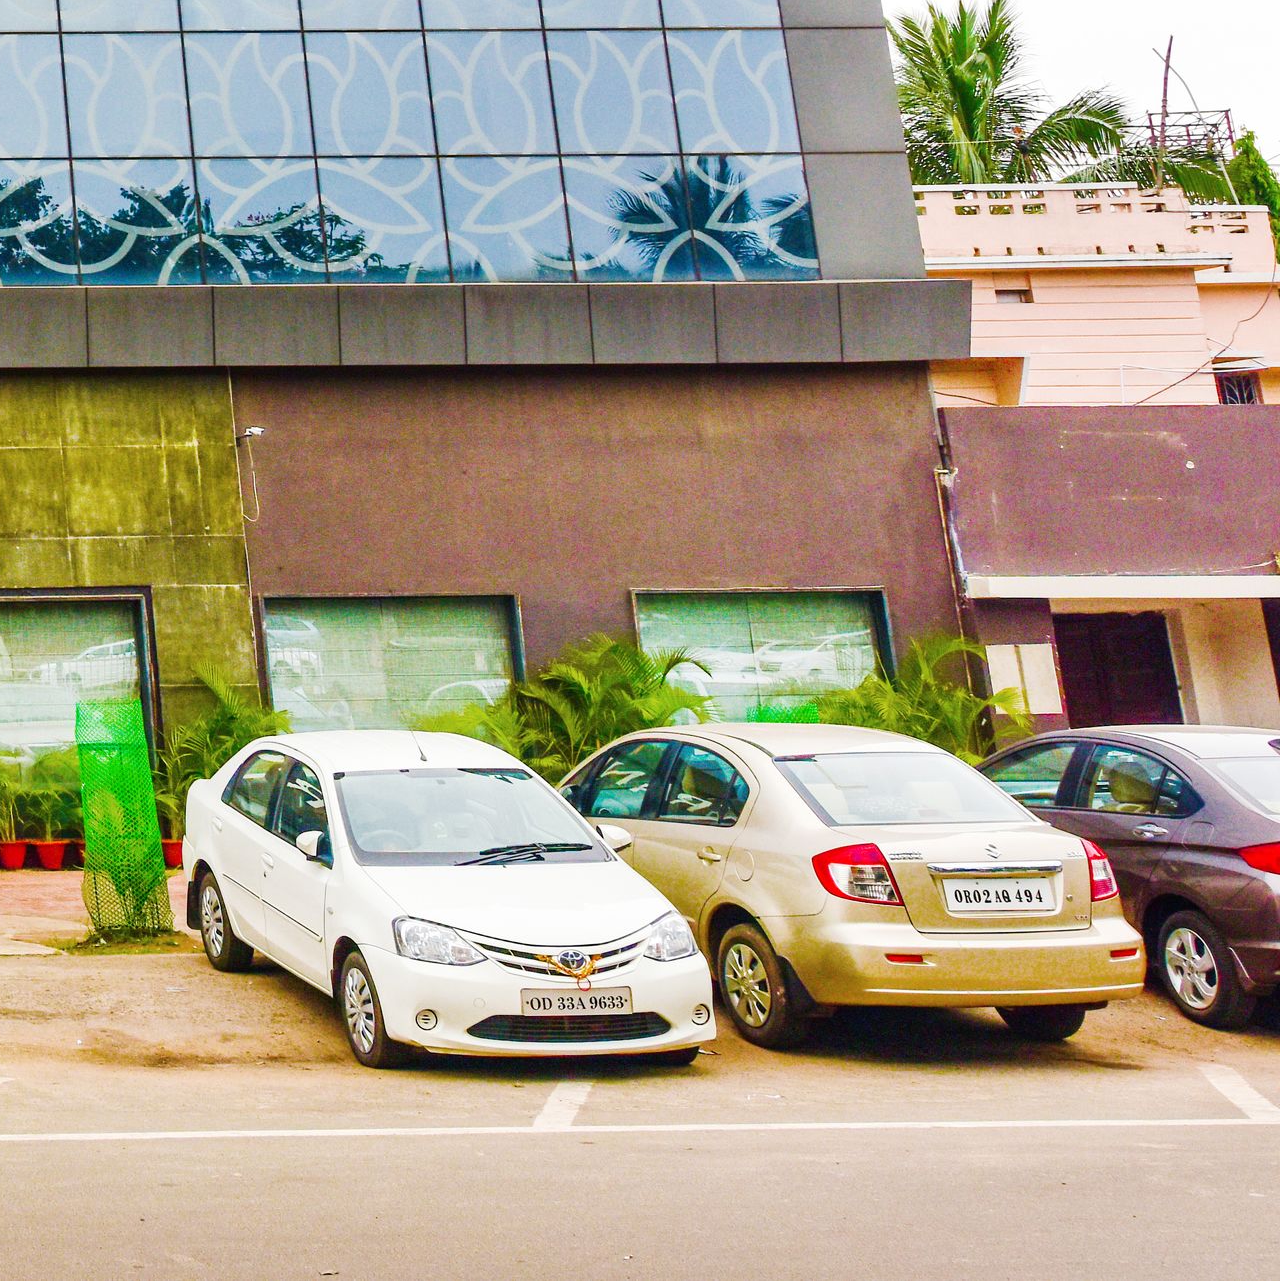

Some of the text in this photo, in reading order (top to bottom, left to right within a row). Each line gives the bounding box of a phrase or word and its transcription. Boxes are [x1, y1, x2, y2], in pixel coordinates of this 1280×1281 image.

[954, 889, 992, 903] OR02
[1015, 888, 1043, 903] 494
[530, 995, 624, 1010] OD 33A 9633
